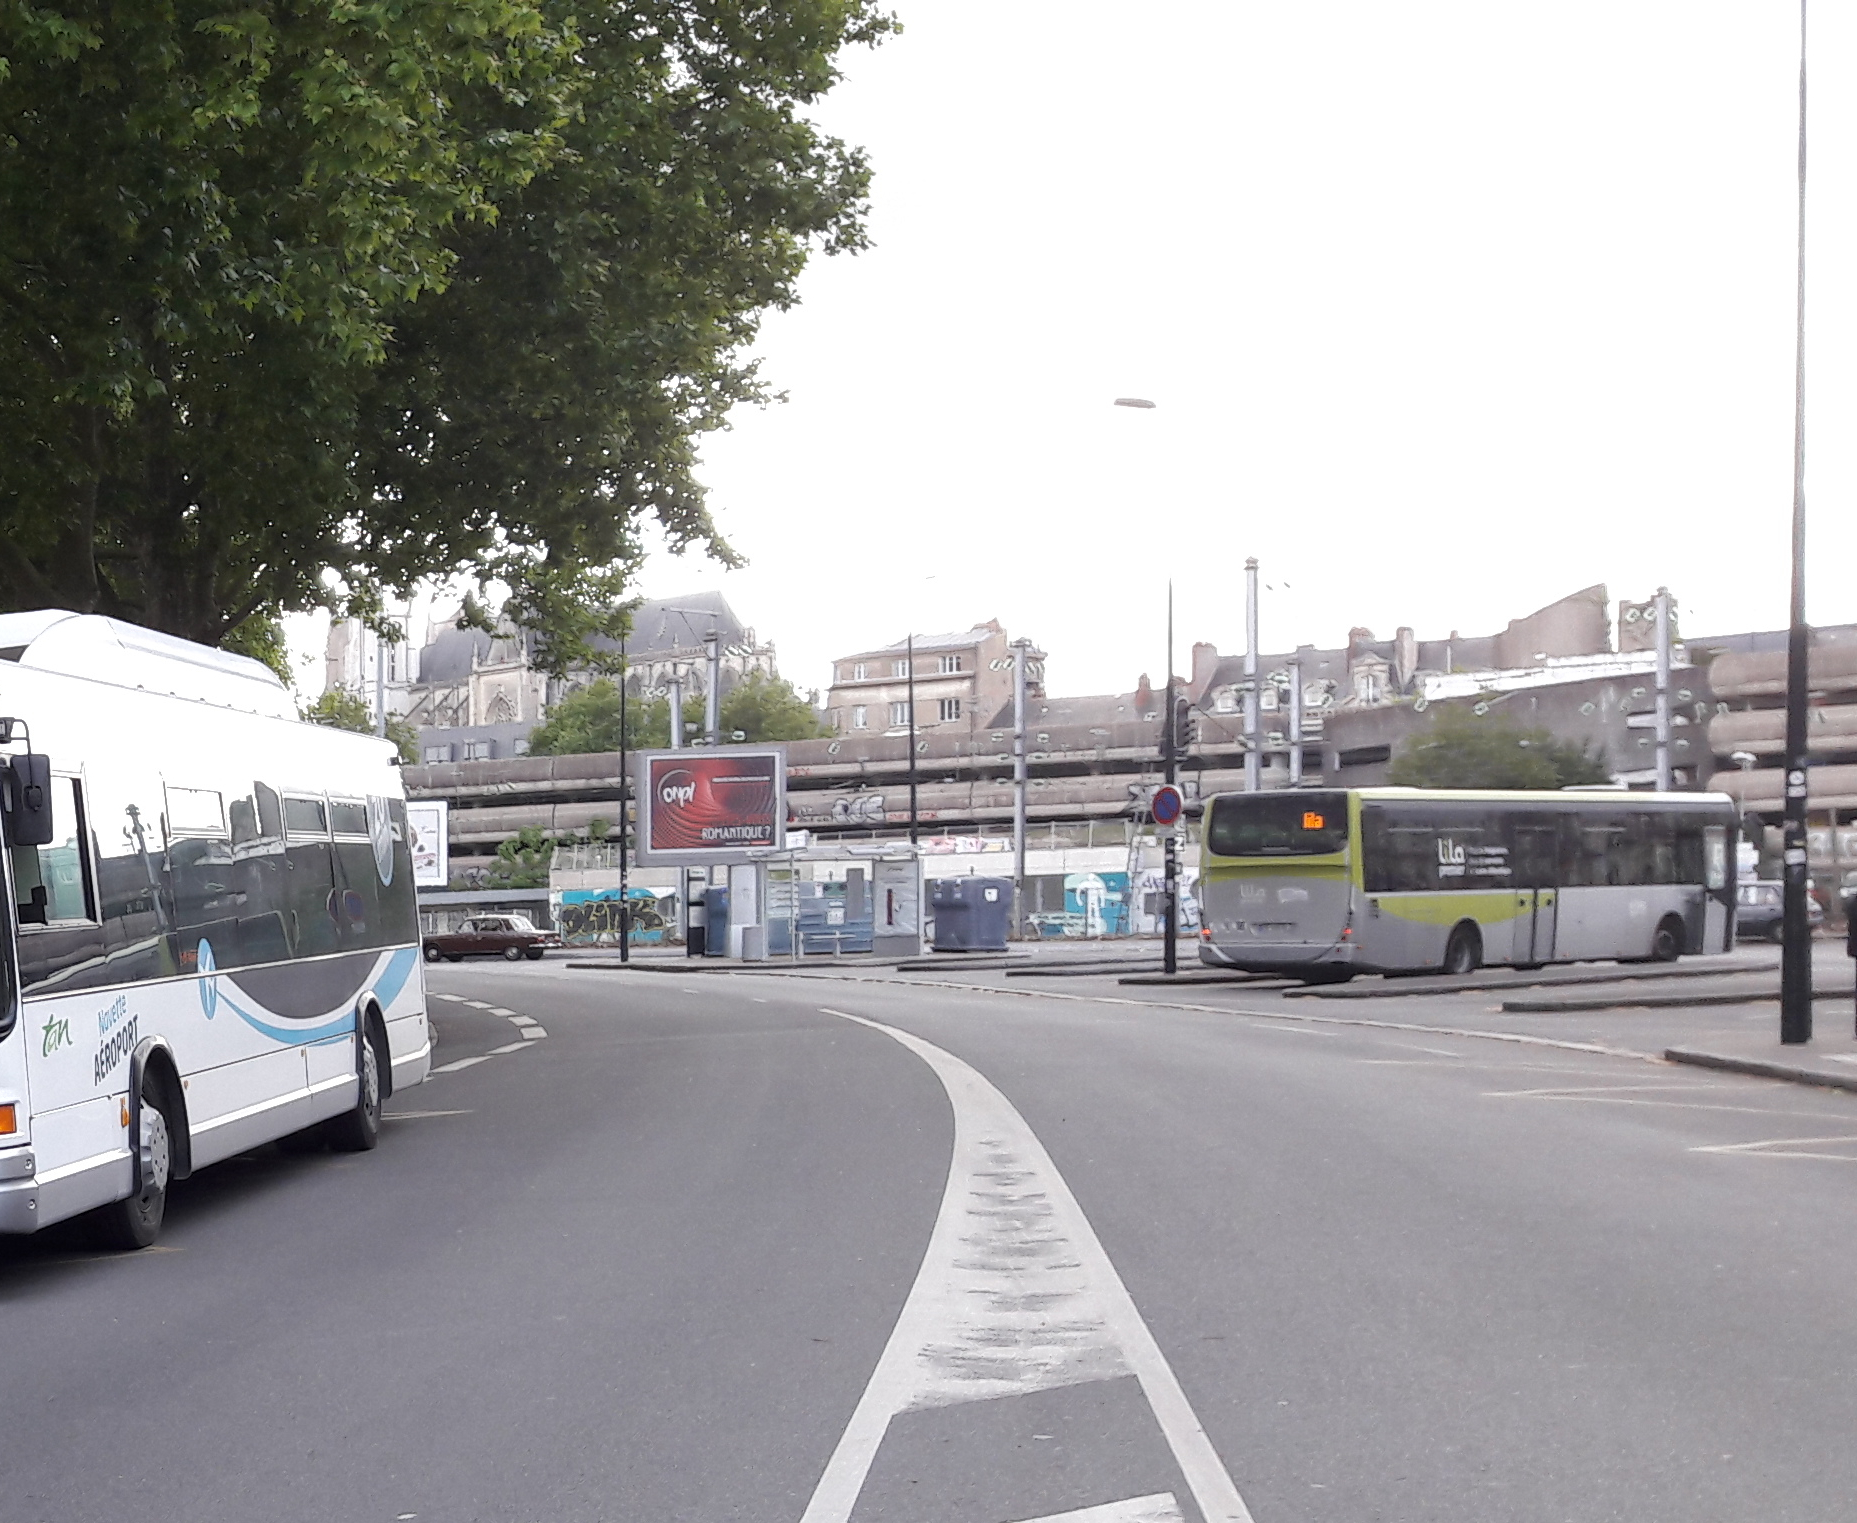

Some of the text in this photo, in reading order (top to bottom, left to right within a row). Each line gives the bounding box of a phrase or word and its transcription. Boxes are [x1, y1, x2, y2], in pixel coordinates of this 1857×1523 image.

[42, 1014, 73, 1058] tan
[97, 994, 127, 1037] Navette
[94, 1014, 139, 1087] AÉROPORT
